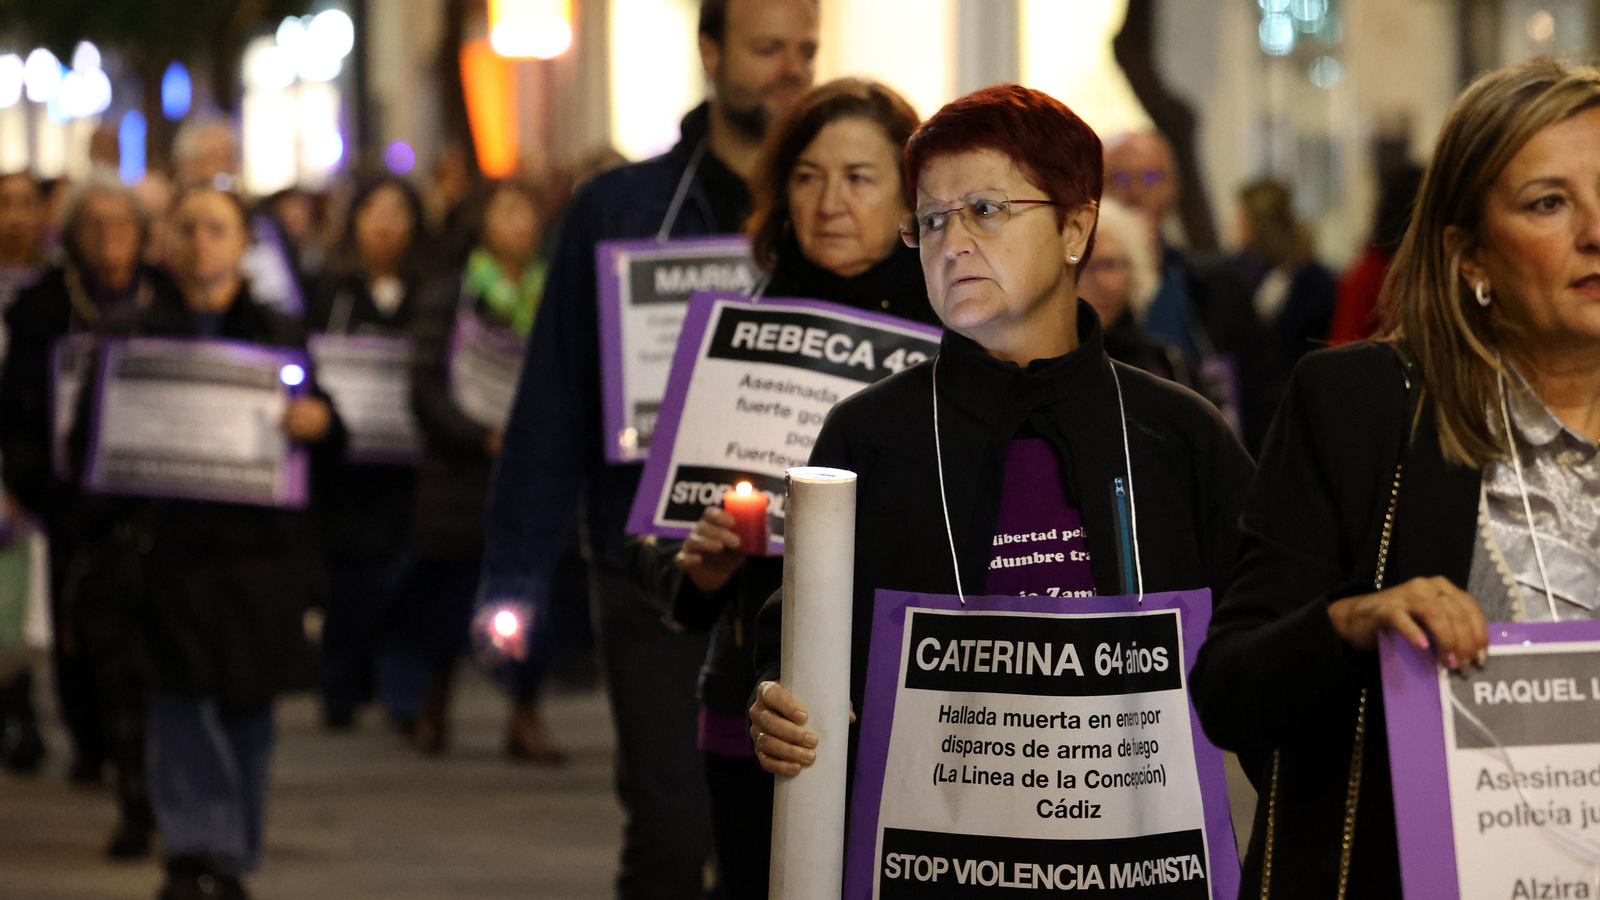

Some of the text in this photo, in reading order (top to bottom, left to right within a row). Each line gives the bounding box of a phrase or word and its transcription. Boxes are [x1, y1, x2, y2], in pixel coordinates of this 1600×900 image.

[731, 321, 875, 370] REBECA
[739, 374, 839, 404] Asesinada
[736, 396, 792, 418] fuerte
[988, 551, 1064, 570] dumbre
[915, 637, 1170, 677] CATERINA 64 años
[1473, 678, 1586, 705] RAQUEL
[938, 705, 1161, 729] Hallada muerta en enero por
[941, 735, 1159, 759] disparos de arma de fuego
[933, 763, 1167, 790] (La Linea de la Concepción)
[1036, 799, 1102, 820] Cádiz
[1478, 800, 1572, 835] policía
[884, 852, 1205, 891] STOP VIOLENCIA MACHISTA
[1511, 876, 1590, 900] Alzira
